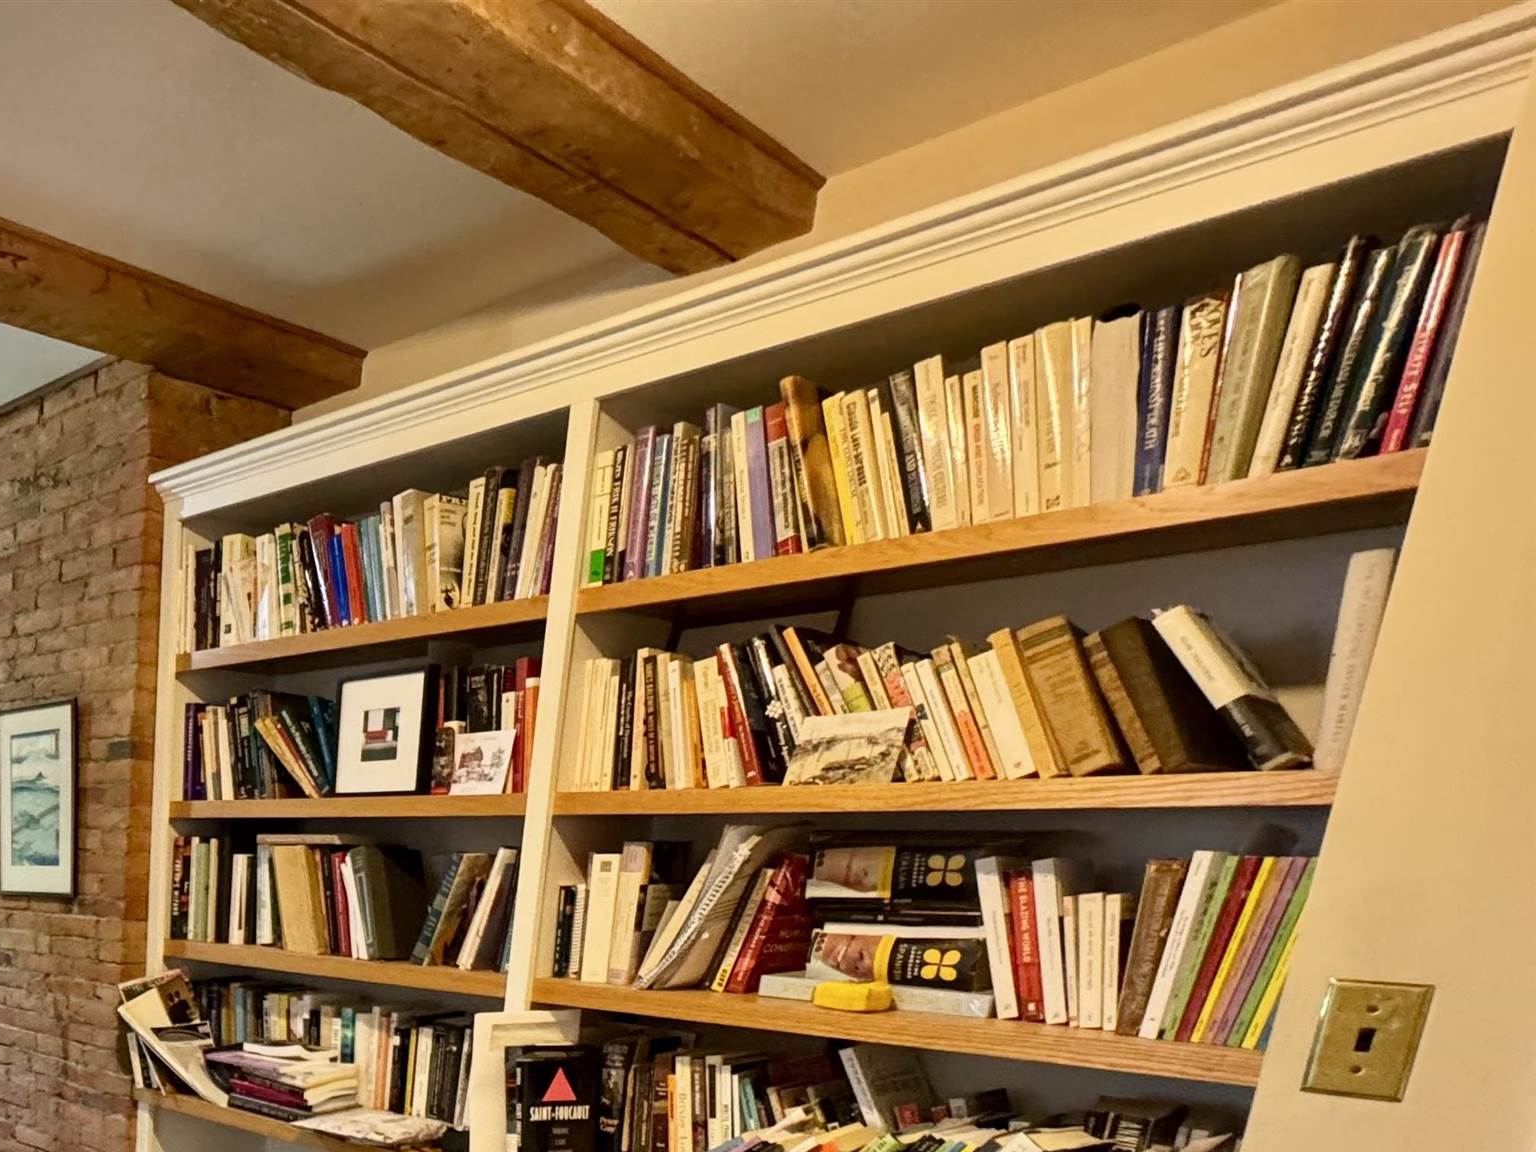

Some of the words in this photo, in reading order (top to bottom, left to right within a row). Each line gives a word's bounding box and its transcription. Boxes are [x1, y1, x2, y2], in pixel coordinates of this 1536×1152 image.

[1144, 411, 1159, 449] DEATH
[611, 479, 621, 502] ERIK
[606, 516, 618, 557] ERIKSON
[1017, 876, 1027, 892] THE
[1019, 894, 1031, 929] BLAZING
[893, 942, 909, 980] SPANISH
[1022, 932, 1033, 963] WORLD
